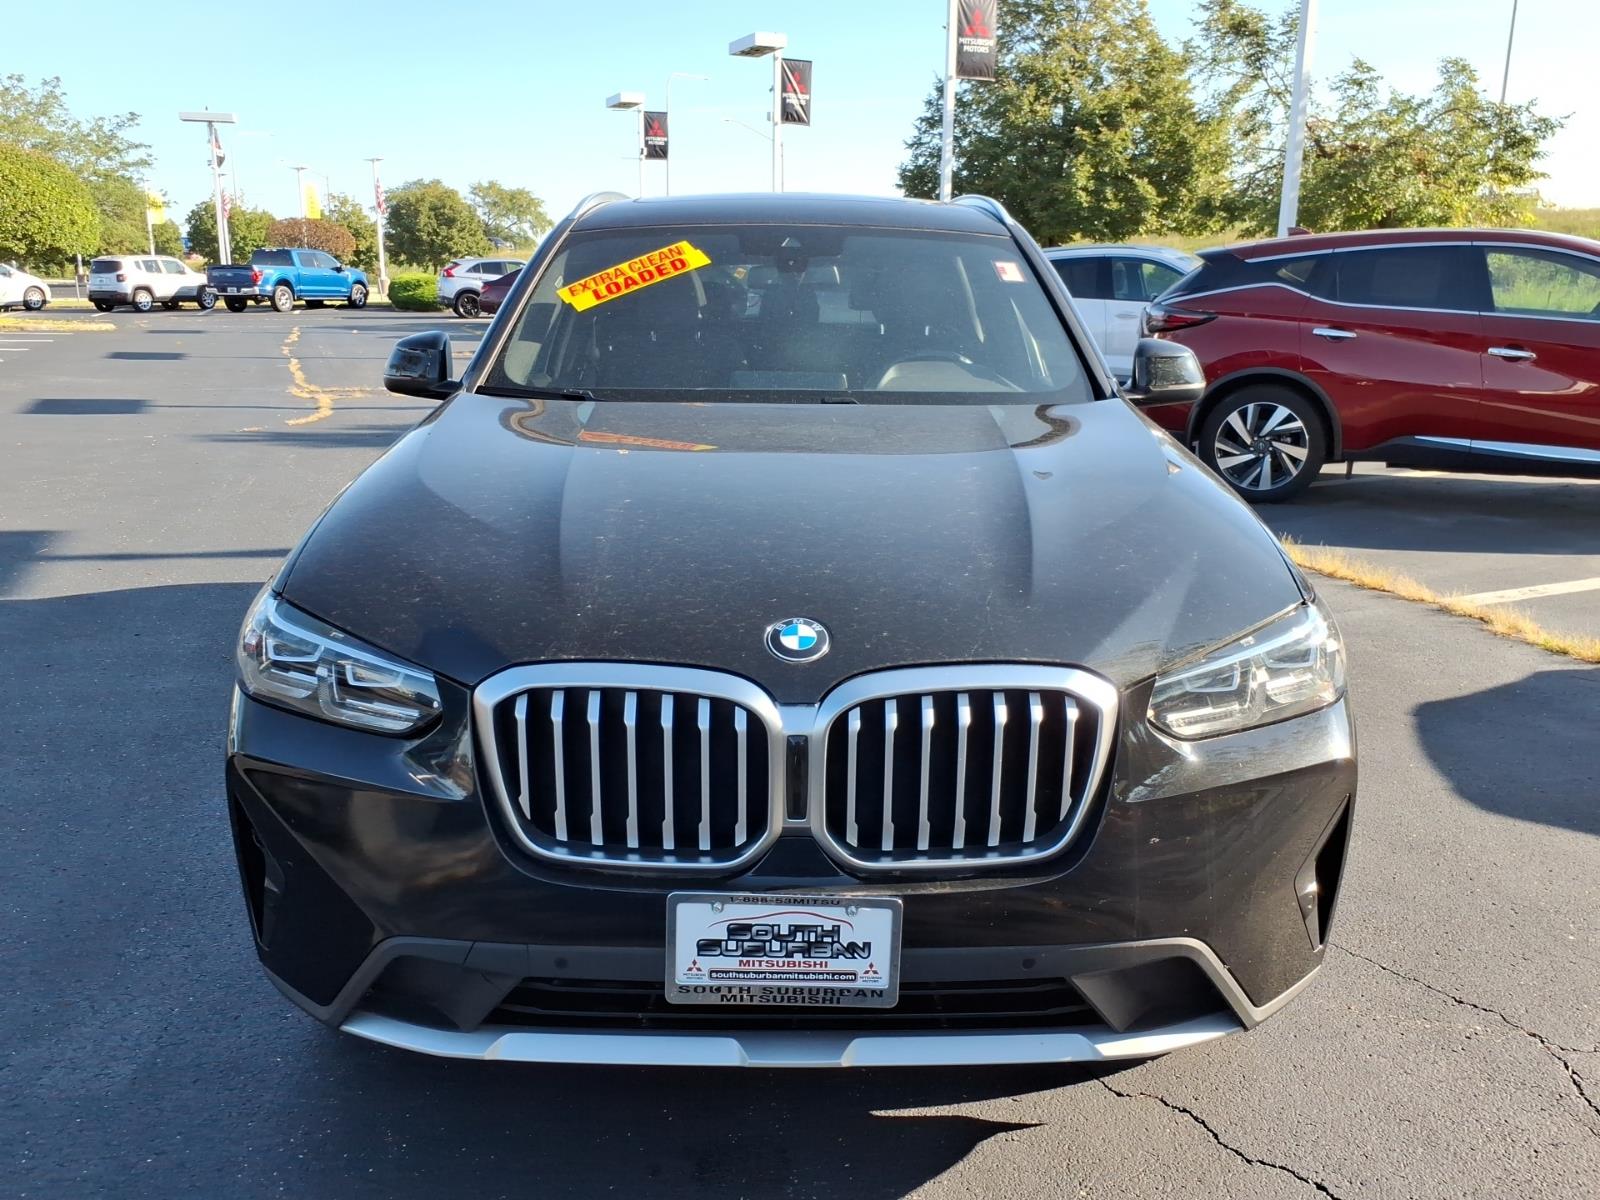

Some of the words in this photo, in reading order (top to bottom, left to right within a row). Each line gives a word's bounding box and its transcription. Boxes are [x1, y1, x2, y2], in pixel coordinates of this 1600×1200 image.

[963, 45, 990, 53] MOTORS
[568, 268, 627, 297] EXTRA
[628, 245, 685, 273] CLEAN
[592, 258, 688, 301] LOADED
[775, 618, 823, 631] BMW
[726, 923, 840, 942] SOUTH
[696, 938, 871, 960] SUBURBAN
[738, 959, 828, 969] MITSUBISHI
[711, 970, 855, 981] southsuburbanmitsubishi.com
[678, 985, 751, 995] SOUTH
[720, 994, 841, 1005] MITSUBISHI
